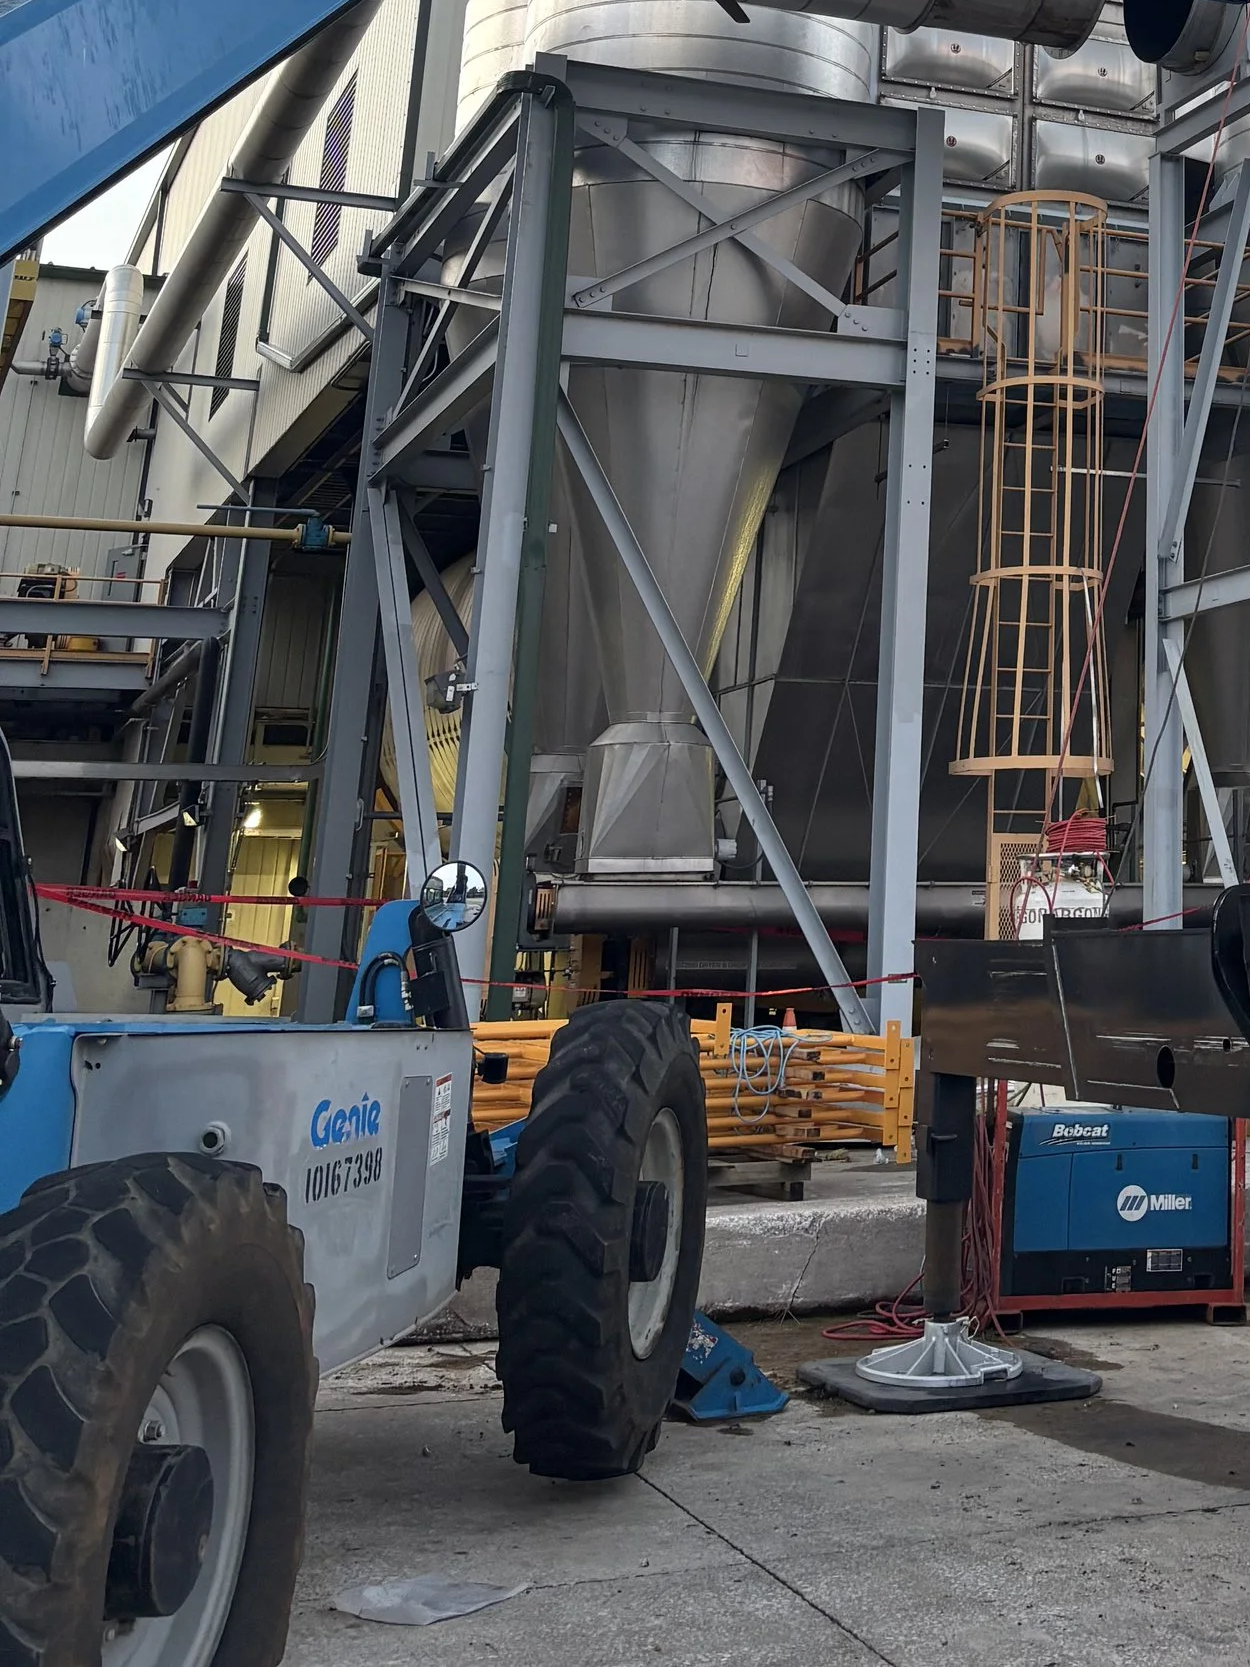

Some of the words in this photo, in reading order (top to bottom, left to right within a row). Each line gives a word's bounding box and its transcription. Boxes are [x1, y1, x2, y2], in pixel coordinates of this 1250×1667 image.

[311, 1091, 381, 1147] Genie
[1052, 1123, 1109, 1137] Bobcat
[305, 1147, 382, 1204] 10167398
[1150, 1194, 1191, 1211] Miller
